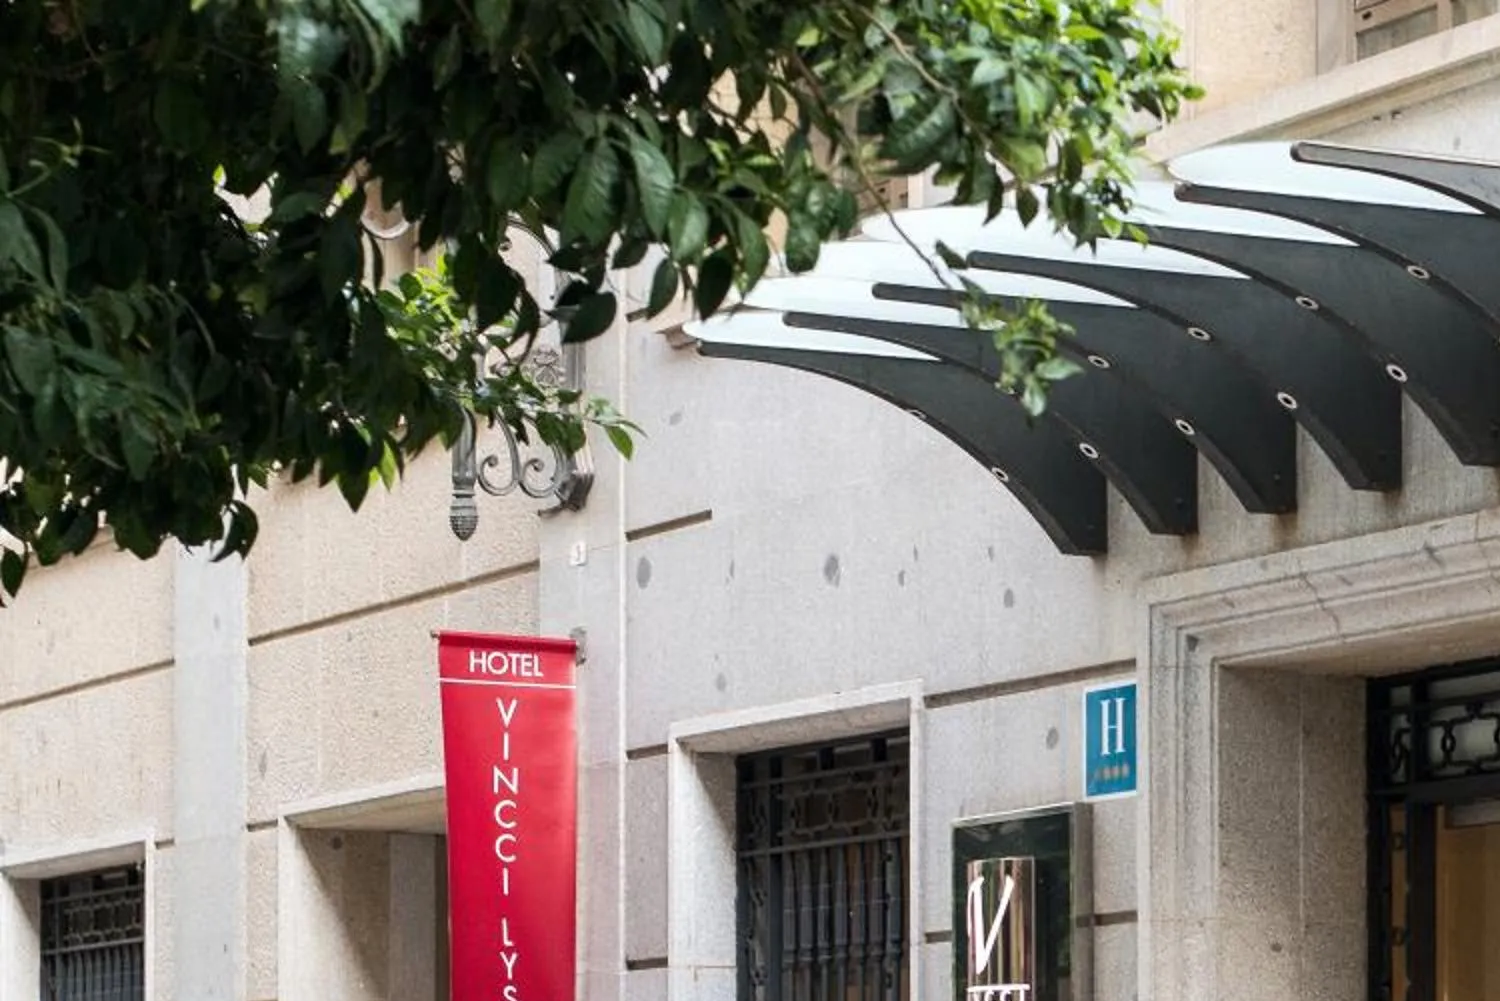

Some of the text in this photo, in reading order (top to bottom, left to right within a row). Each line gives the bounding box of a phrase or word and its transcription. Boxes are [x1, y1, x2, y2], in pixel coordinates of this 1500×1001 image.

[468, 650, 544, 677] HOTEL
[1100, 697, 1126, 756] H
[493, 697, 519, 896] VINCCI
